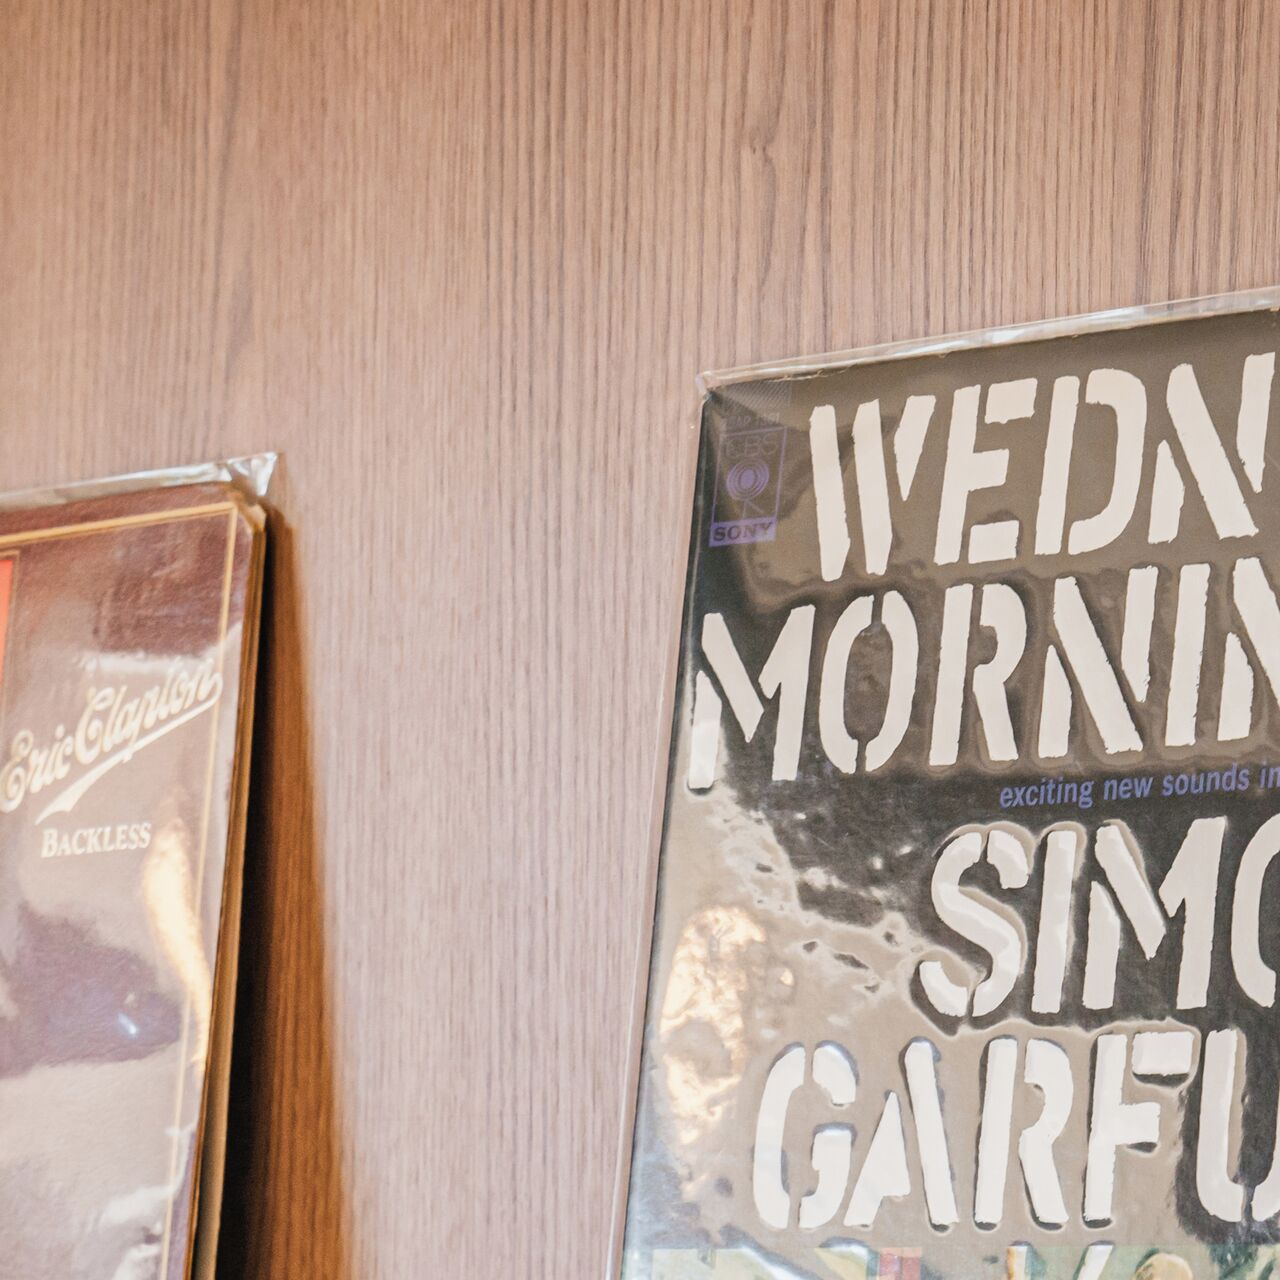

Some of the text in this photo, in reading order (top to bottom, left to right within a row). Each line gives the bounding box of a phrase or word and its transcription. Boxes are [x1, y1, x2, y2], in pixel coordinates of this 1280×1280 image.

[725, 432, 779, 460] CBS
[713, 521, 773, 543] SONY
[70, 657, 224, 768] Clapton
[999, 776, 1096, 809] exciting
[1103, 774, 1154, 801] new
[1161, 762, 1250, 797] sounds
